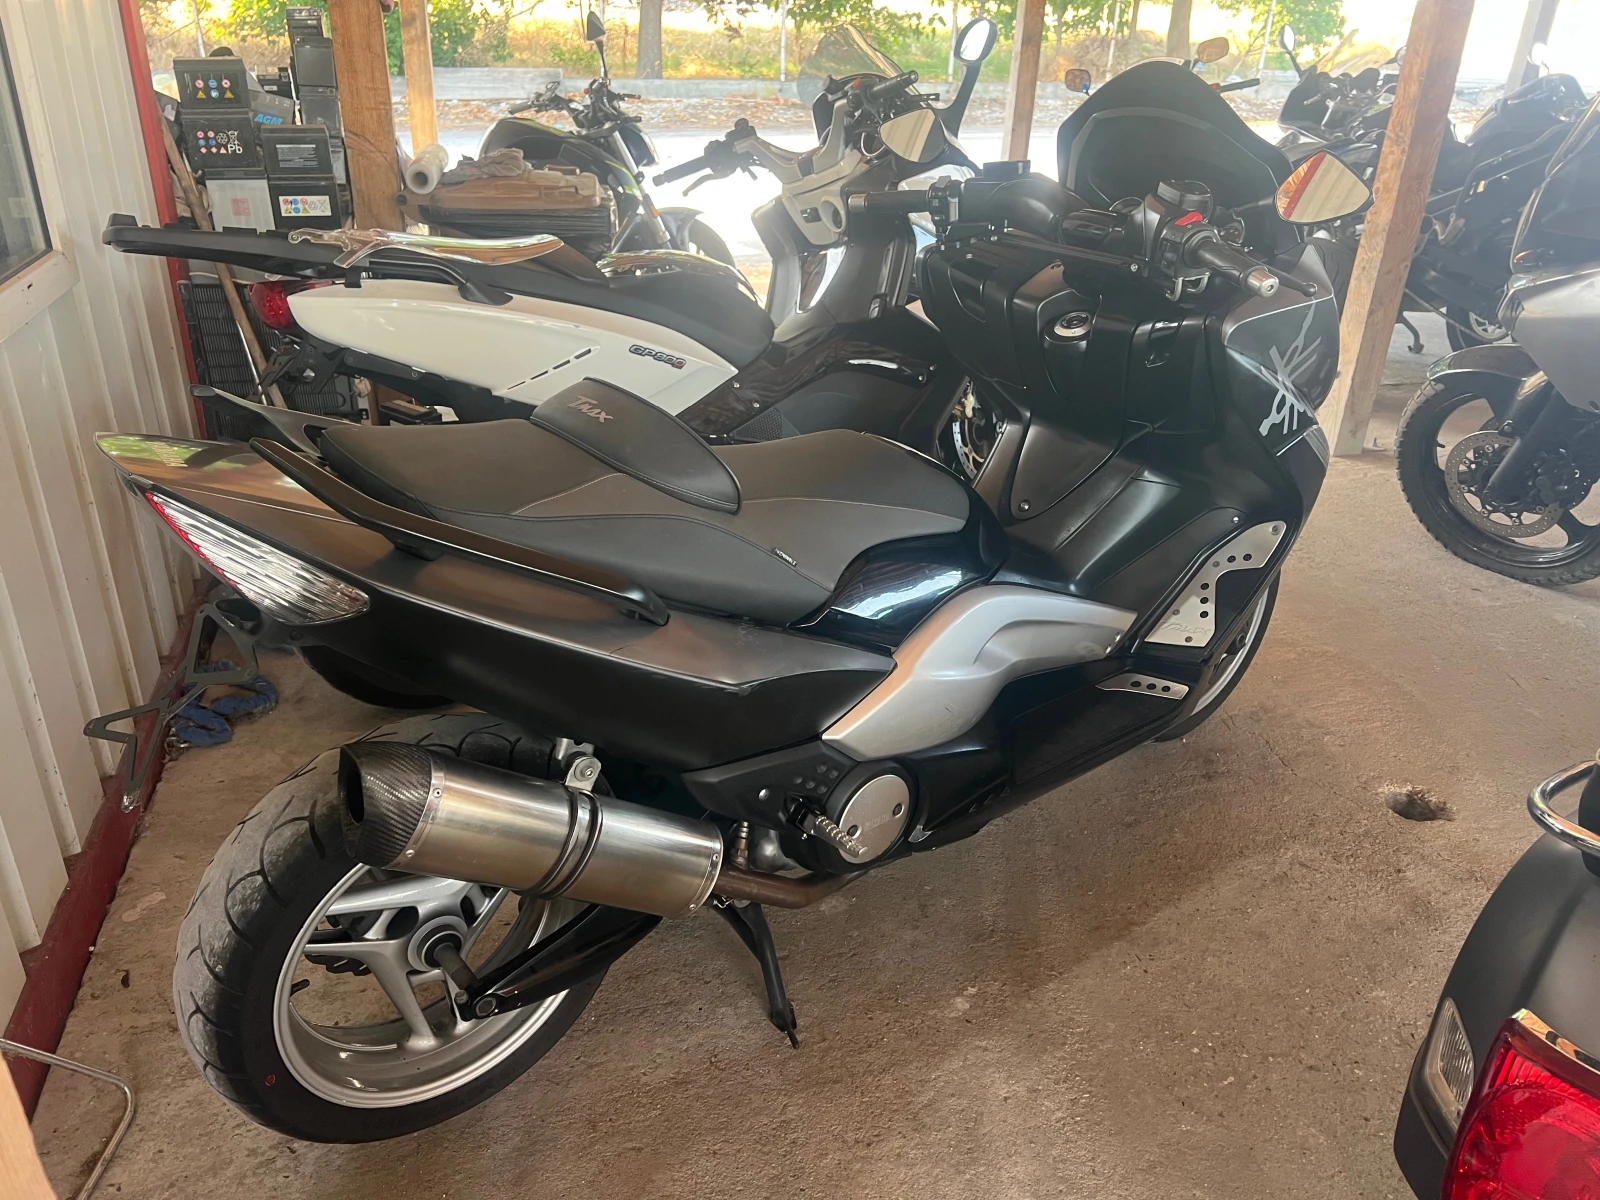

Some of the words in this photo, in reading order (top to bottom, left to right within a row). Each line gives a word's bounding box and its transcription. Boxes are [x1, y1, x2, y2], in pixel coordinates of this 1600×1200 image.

[254, 113, 283, 125] AGM
[227, 144, 243, 154] Pb
[629, 344, 686, 369] GP800
